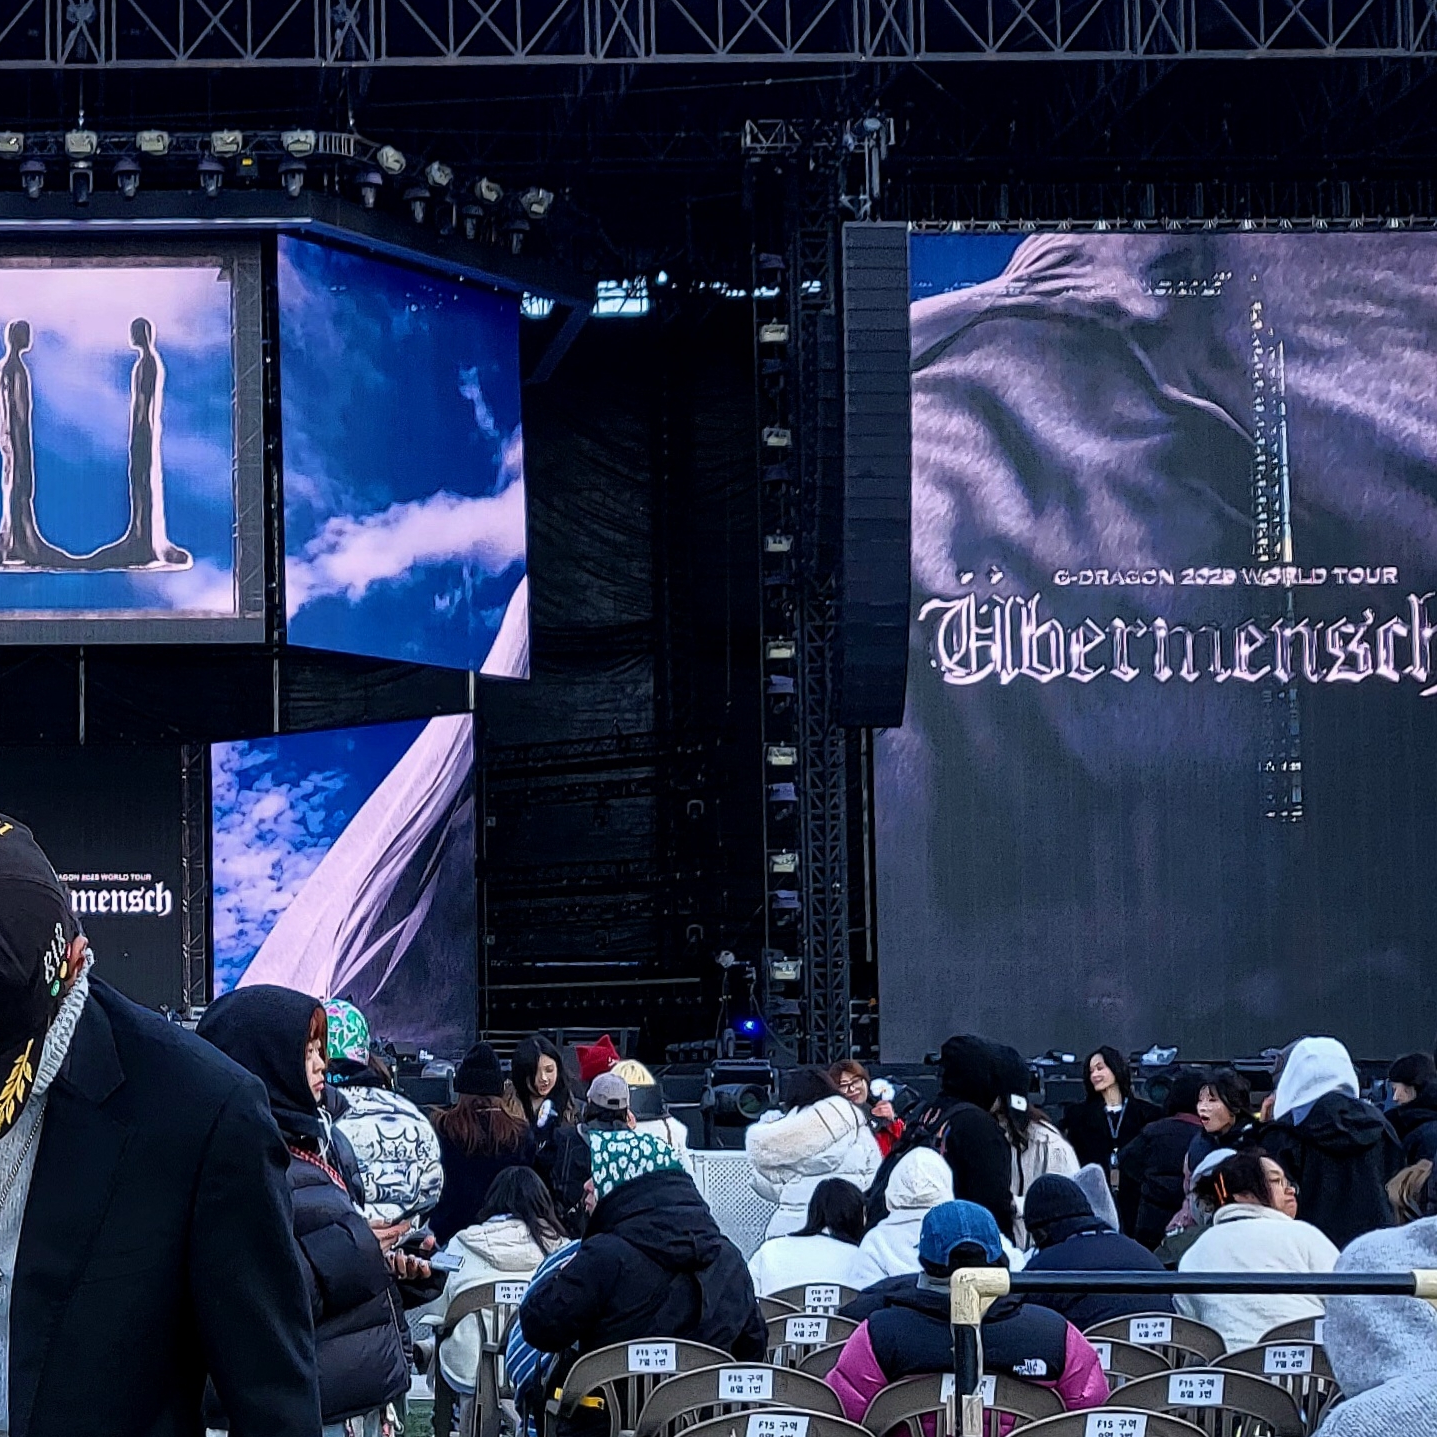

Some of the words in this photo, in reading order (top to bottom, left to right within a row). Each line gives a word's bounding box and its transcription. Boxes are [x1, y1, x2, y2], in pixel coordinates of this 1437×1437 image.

[1054, 568, 1175, 586] G-DRAGON
[1240, 566, 1327, 587] WORLD
[1331, 566, 1399, 584] TOUR
[101, 873, 129, 881] WORLD
[130, 873, 152, 881] TOUR
[70, 880, 172, 916] mensch
[747, 1374, 764, 1383] 구역
[1198, 1378, 1215, 1388] 구역
[749, 1384, 761, 1394] 1번
[758, 1421, 775, 1430] F15
[779, 1421, 798, 1431] 구역
[1097, 1419, 1114, 1428] F15
[1119, 1419, 1137, 1430] 구역
